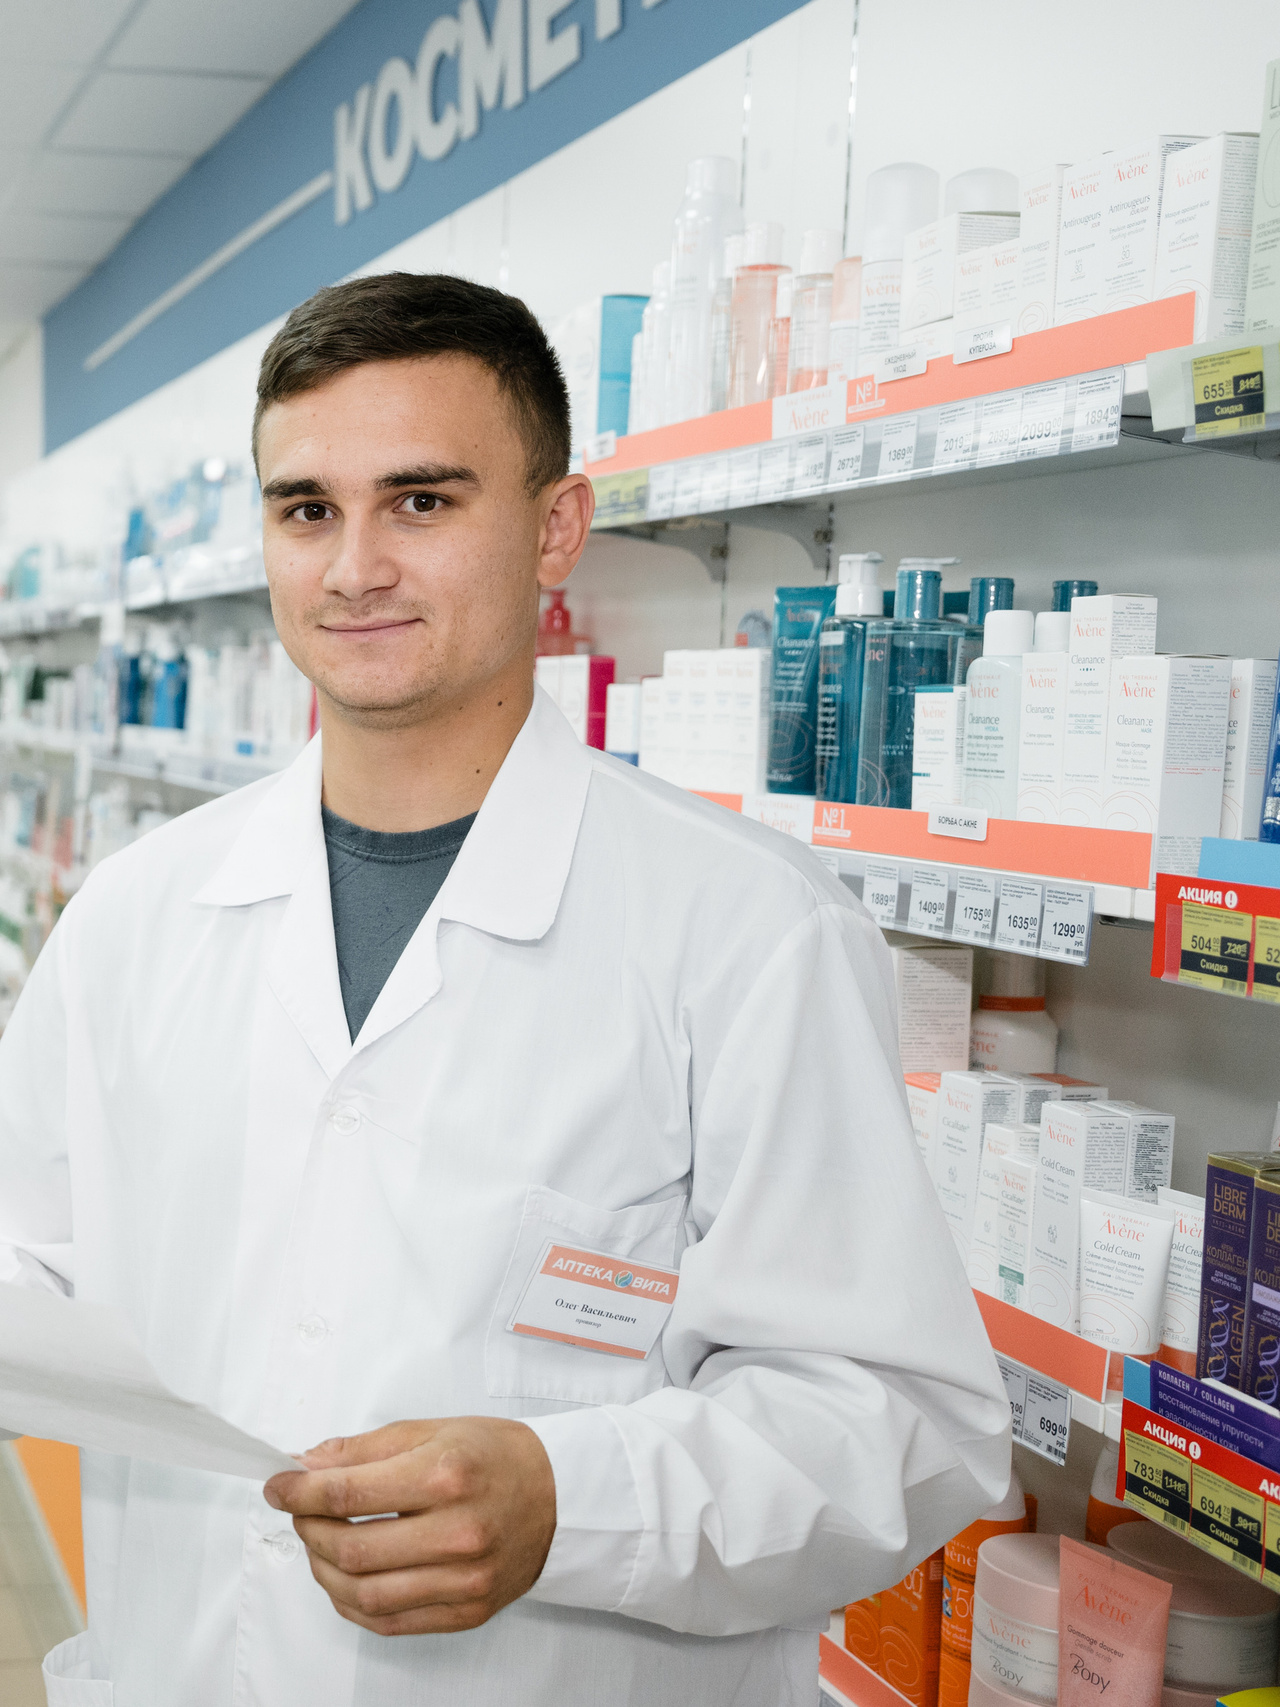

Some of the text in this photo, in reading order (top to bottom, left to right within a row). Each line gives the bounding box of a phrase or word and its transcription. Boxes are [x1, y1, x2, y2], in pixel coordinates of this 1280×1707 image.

[333, 0, 668, 226] КОСМЕ
[1113, 163, 1149, 184] Avène
[1068, 181, 1100, 200] Avène
[1108, 195, 1151, 215] Antirougeurs
[1062, 210, 1102, 230] Antirougeurs
[1121, 249, 1131, 261] 30
[972, 330, 994, 342] ПРОТИВ
[969, 341, 997, 355] КУПЕРОЗА
[1203, 382, 1225, 400] 655
[789, 407, 830, 431] Avène
[1085, 407, 1110, 426] 1894
[1214, 403, 1245, 417] Скидка
[988, 429, 1009, 445] 2099
[1021, 420, 1052, 442] 2099
[944, 437, 964, 451] 2019
[837, 457, 854, 471] 2673
[888, 449, 906, 462] 1369
[1073, 623, 1105, 637] Avène
[1071, 654, 1105, 665] Cleanance
[969, 682, 999, 698] Avène
[1027, 674, 1057, 688] Avène
[1119, 681, 1156, 698] Avène
[1026, 704, 1056, 715] Cleanance
[822, 807, 845, 829] №1
[938, 816, 958, 826] БОРЬБА
[963, 819, 978, 829] АКНЕ
[871, 892, 889, 906] 1889
[1178, 886, 1223, 905] АКЦИЯ
[919, 900, 938, 915] 1409
[964, 906, 985, 922] 1755
[1008, 914, 1030, 930] 1635
[1052, 922, 1076, 938] 1299
[1191, 934, 1212, 952] 504
[1266, 947, 1280, 964] 52
[1200, 958, 1229, 974] Скидка
[945, 1092, 972, 1113] Avène
[1046, 1124, 1075, 1147] Avène
[1041, 1156, 1076, 1177] Cold Cream
[1003, 1175, 1027, 1193] Avène
[1214, 1183, 1248, 1206] LIBRE
[1102, 1211, 1150, 1228] EAU THERMALE
[1176, 1211, 1188, 1219] EAU
[1213, 1198, 1247, 1222] DERM
[1099, 1218, 1145, 1242] Avène
[1093, 1239, 1141, 1261] Cold Cream
[1206, 1245, 1249, 1269] КОЛЛАГЕН
[1084, 1258, 1144, 1280] Concentrated hand cream
[1085, 1250, 1145, 1273] Crème mains concentrée
[1172, 1256, 1187, 1265] mains
[1184, 1265, 1197, 1275] hand
[552, 1257, 671, 1296] АПТЕКА ВИТА
[1211, 1276, 1242, 1293] КОНТУРА ГЛАЗ
[555, 1298, 637, 1325] Олег Васильевич
[1248, 1324, 1256, 1353] CREAM
[1158, 1369, 1235, 1414] КОЛЛАГЕН COLLAGEN
[1039, 1416, 1058, 1437] 699
[1158, 1391, 1220, 1427] восстановление
[1221, 1421, 1264, 1449] упругости
[1143, 1420, 1187, 1452] АКЦИЯ
[1158, 1407, 1239, 1454] и эластичности кожи
[1133, 1459, 1155, 1481] 783
[1142, 1485, 1170, 1507] Скидка
[1200, 1496, 1222, 1519] 694
[1209, 1523, 1239, 1547] Скидка
[1077, 1572, 1140, 1607] EAU THERMALE
[1074, 1584, 1132, 1627] Avène
[989, 1616, 1031, 1648] Avène
[1066, 1624, 1125, 1659] Gommage douceur
[993, 1640, 1019, 1657] hydratant
[1074, 1638, 1114, 1664] Gentle scrub
[1069, 1652, 1111, 1695] BODY
